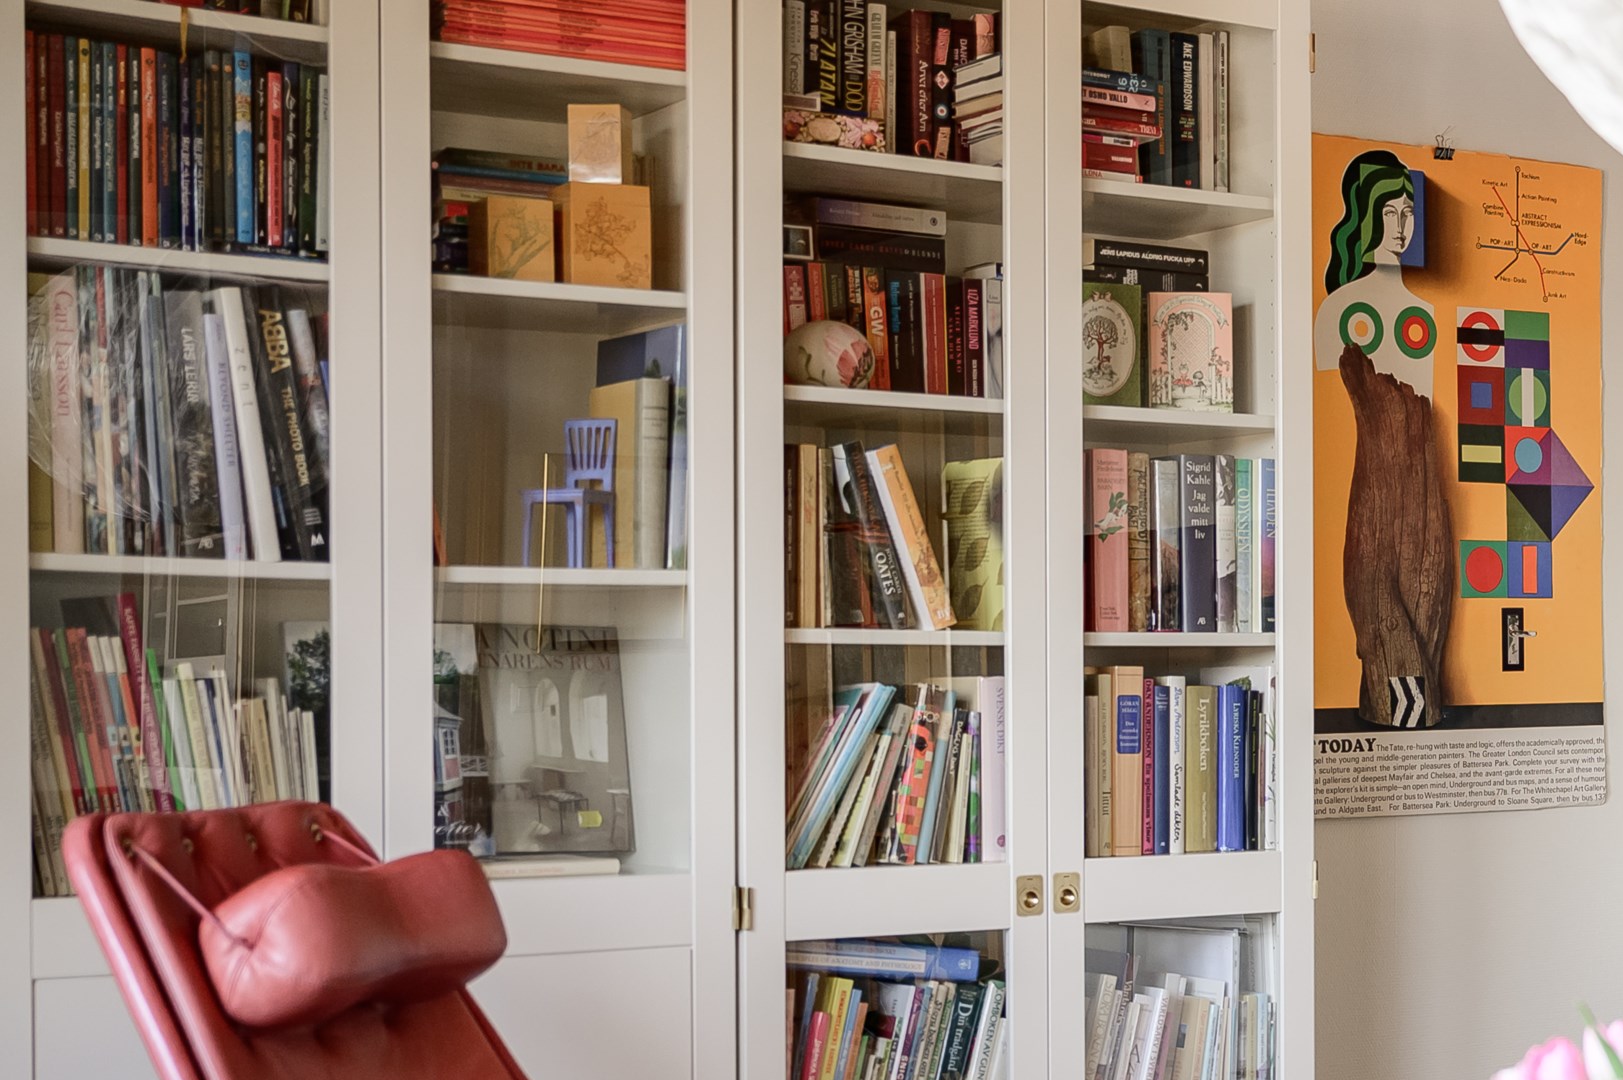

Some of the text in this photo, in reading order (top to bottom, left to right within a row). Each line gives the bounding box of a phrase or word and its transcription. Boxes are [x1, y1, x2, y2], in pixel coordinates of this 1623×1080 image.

[1182, 42, 1194, 60] ÅKE
[844, 22, 864, 111] GRISHAM DÖD
[1183, 61, 1193, 110] EDWARDSON
[918, 60, 929, 132] Arvet efter Arn
[1108, 92, 1128, 104] VALLO
[1538, 195, 1557, 204] Painting
[1522, 212, 1548, 220] ABSTRACT
[1522, 220, 1562, 229] EXPRESSIONISM
[1574, 238, 1587, 246] Edge
[1116, 250, 1140, 258] LAPIDUS
[1142, 252, 1162, 260] ALDRIG
[53, 290, 76, 332] Carl
[967, 289, 980, 350] LIZA MARKLUND
[870, 306, 884, 336] GW
[180, 328, 200, 404] LARS LERIN
[258, 309, 292, 374] ABBA
[284, 412, 302, 452] PHOTO
[294, 454, 310, 486] BOOK
[1186, 460, 1211, 473] Sigrid
[1186, 474, 1211, 485] Kahle
[1192, 490, 1206, 502] Jag
[1188, 503, 1210, 513] valde
[1191, 518, 1209, 526] mitt
[1194, 530, 1205, 540] liv
[874, 552, 896, 596] OATES
[1144, 680, 1152, 700] DAN
[996, 688, 1005, 728] SVENSK
[1144, 702, 1152, 758] ANDERSSON
[1198, 698, 1210, 772] Lyrikboken
[1318, 738, 1376, 753] TODAY
[1407, 743, 1433, 752] re-hung
[1526, 738, 1564, 747] academically
[1173, 686, 1184, 843] Dan Andersson Samlade dikter
[1233, 735, 1241, 778] KLENODER
[1338, 757, 1359, 765] young
[1376, 752, 1436, 762] middle-generation
[1532, 748, 1555, 756] Council
[1319, 766, 1350, 775] sculpture
[1353, 764, 1377, 774] against
[1393, 763, 1417, 772] simpler
[1420, 762, 1451, 771] pleasures
[1513, 758, 1542, 767] Complete
[1322, 776, 1350, 786] galleries
[1360, 774, 1387, 784] deepest
[1388, 773, 1414, 783] Mayfair
[1431, 772, 1457, 780] Chelsea,
[1485, 768, 1522, 778] avant-garde
[1326, 785, 1358, 795] explorer's
[1449, 779, 1491, 789] Underground
[1351, 793, 1394, 803] Underground
[1424, 790, 1467, 799] Westminster,
[1535, 785, 1572, 794] Whitechapel
[1584, 784, 1606, 792] Gallery
[1338, 805, 1364, 815] Aldgate
[1454, 798, 1496, 808] Underground
[1531, 796, 1554, 805] Square,
[1151, 997, 1170, 1051] VÄRLDSARV
[946, 1002, 973, 1072] Din trädgård
[982, 1044, 990, 1058] AV
